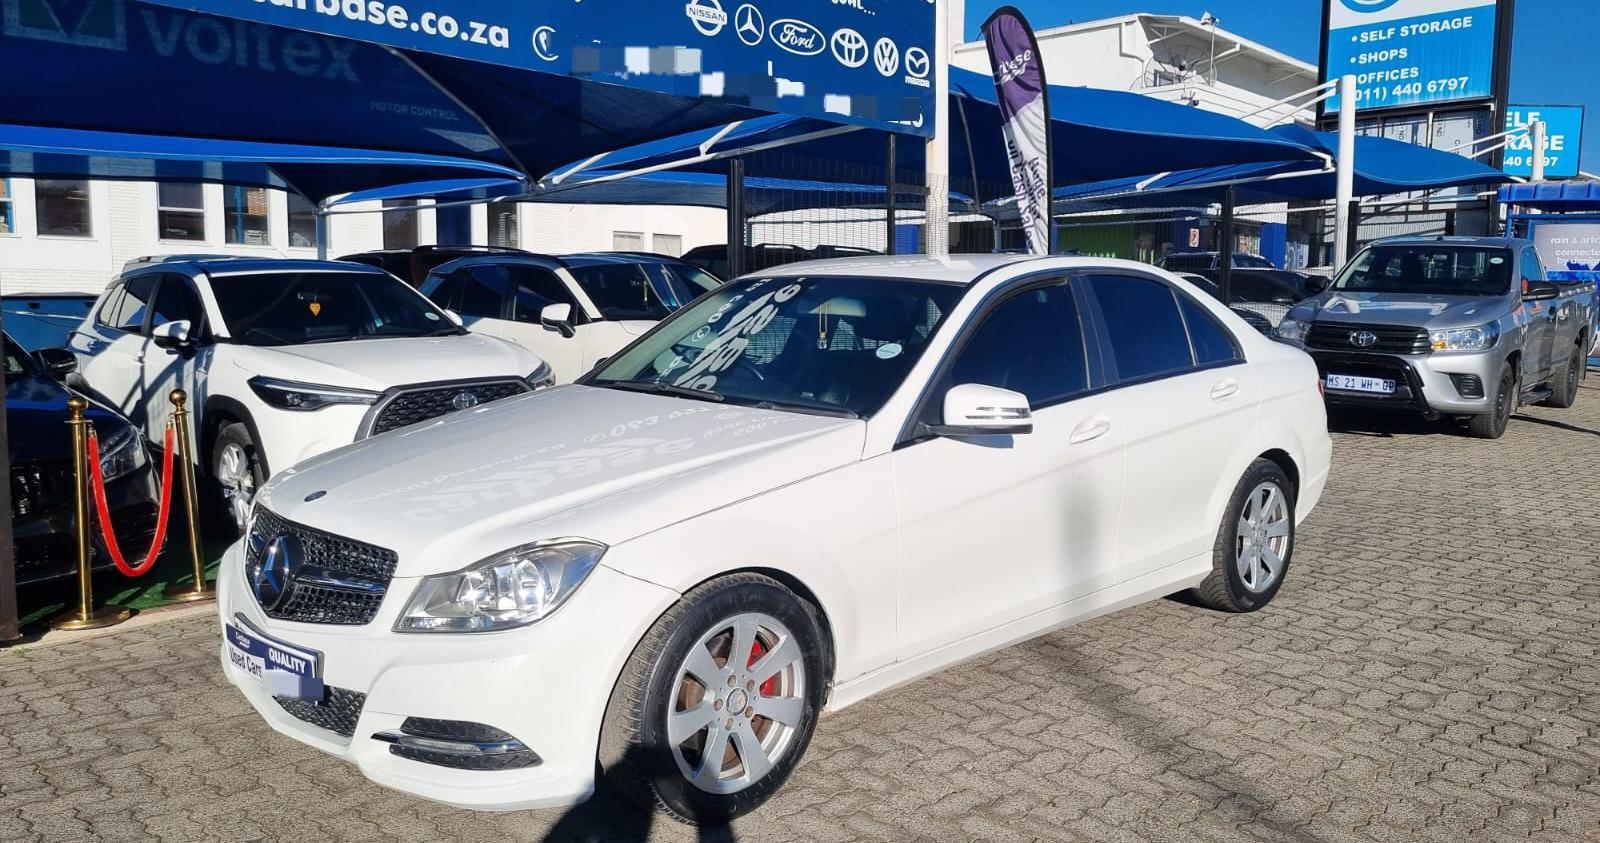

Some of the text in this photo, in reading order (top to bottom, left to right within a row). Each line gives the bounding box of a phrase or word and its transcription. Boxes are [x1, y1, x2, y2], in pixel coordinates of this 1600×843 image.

[688, 7, 725, 22] NISSAN
[779, 23, 816, 49] Ford
[1359, 16, 1473, 43] SELF STORAGE
[141, 9, 359, 82] voltex
[1358, 48, 1408, 64] SHOPS
[1356, 67, 1419, 84] OFFICES
[1391, 82, 1422, 97] 440
[1427, 77, 1469, 93] 6797
[370, 101, 460, 121] MOTOR CONTROL
[1526, 156, 1559, 167] 697
[1327, 375, 1396, 391] MS 21 WH GP
[230, 645, 263, 678] Used Cars
[269, 648, 306, 673] QUALITY
